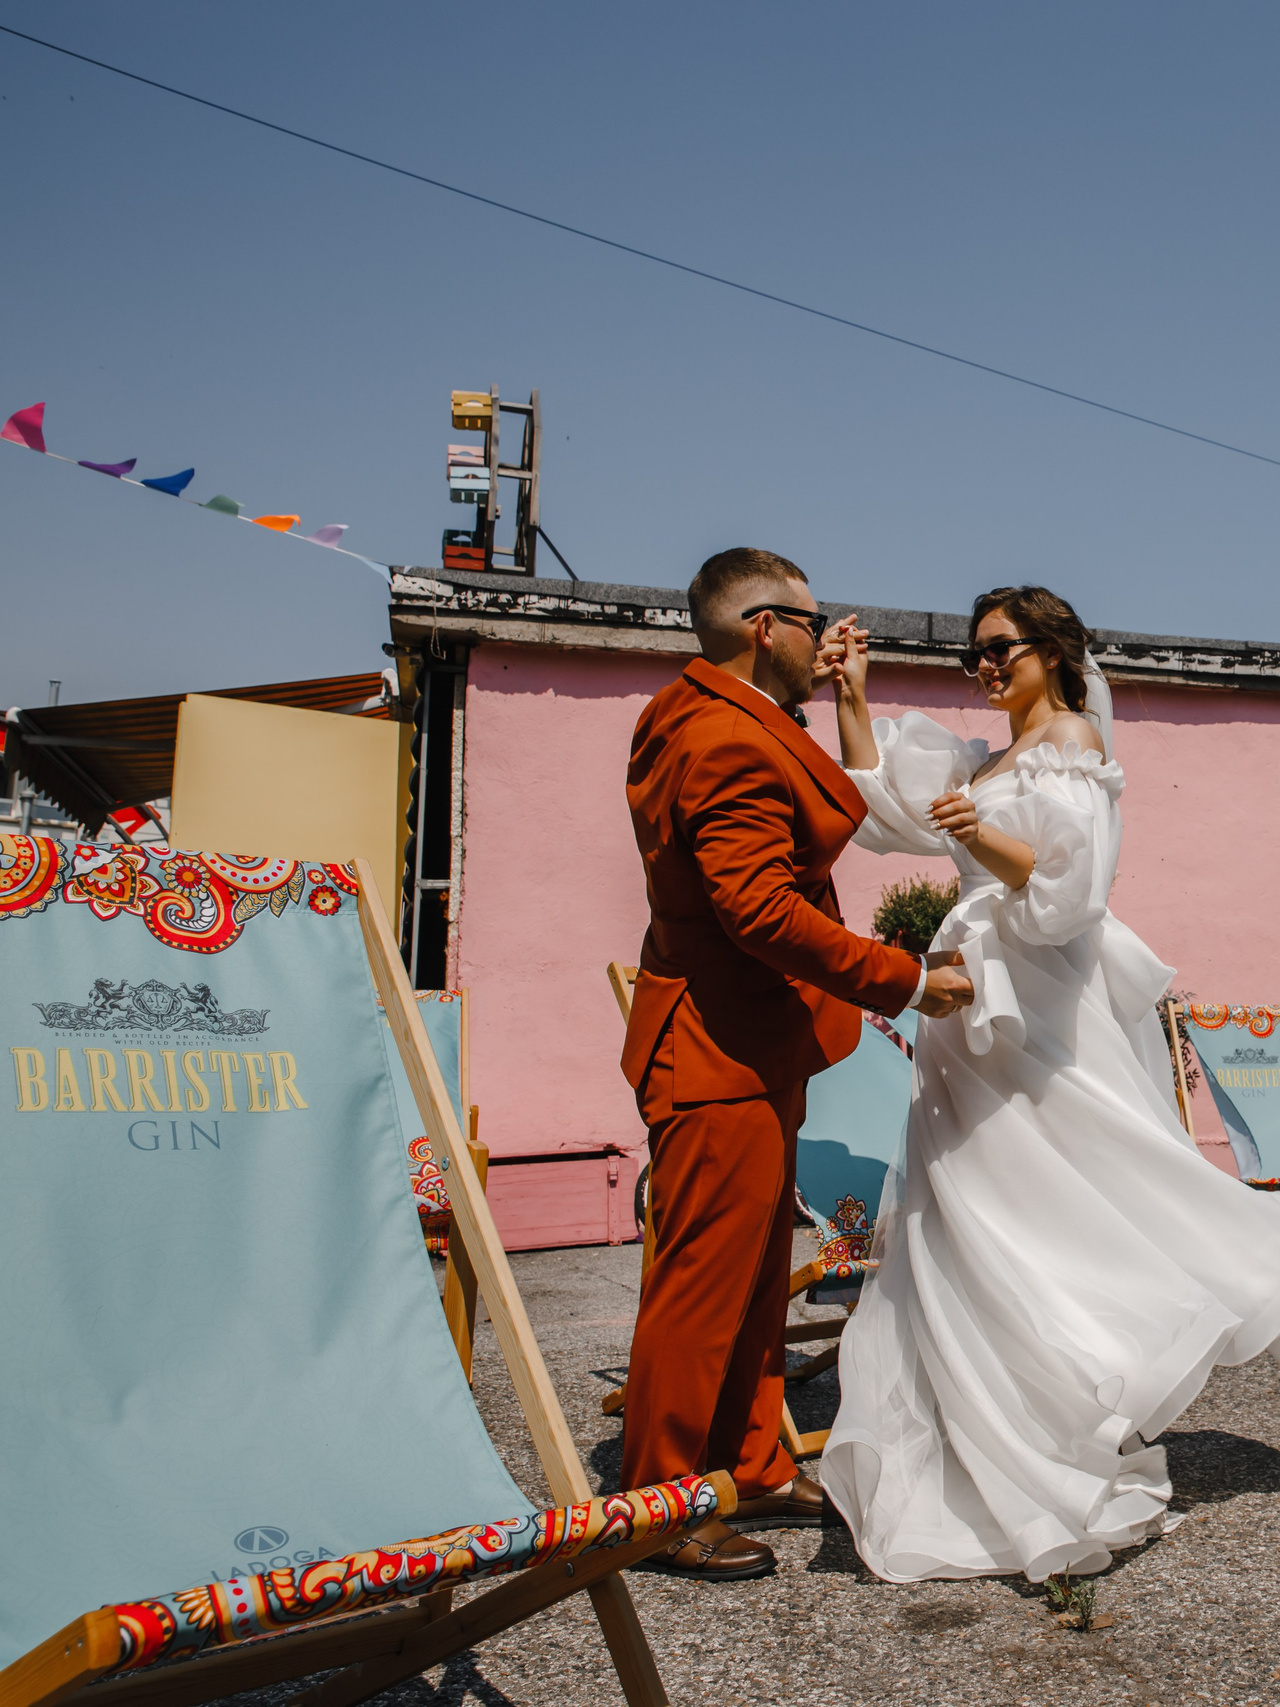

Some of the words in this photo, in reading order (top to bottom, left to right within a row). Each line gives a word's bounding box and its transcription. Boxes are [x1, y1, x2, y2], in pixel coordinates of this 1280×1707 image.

[195, 1034, 260, 1043] ACCORDANCE
[10, 1046, 309, 1114] BARRISTER
[1242, 1089, 1266, 1097] GIN
[127, 1120, 222, 1151] GIN
[210, 1545, 337, 1582] LADOGA
